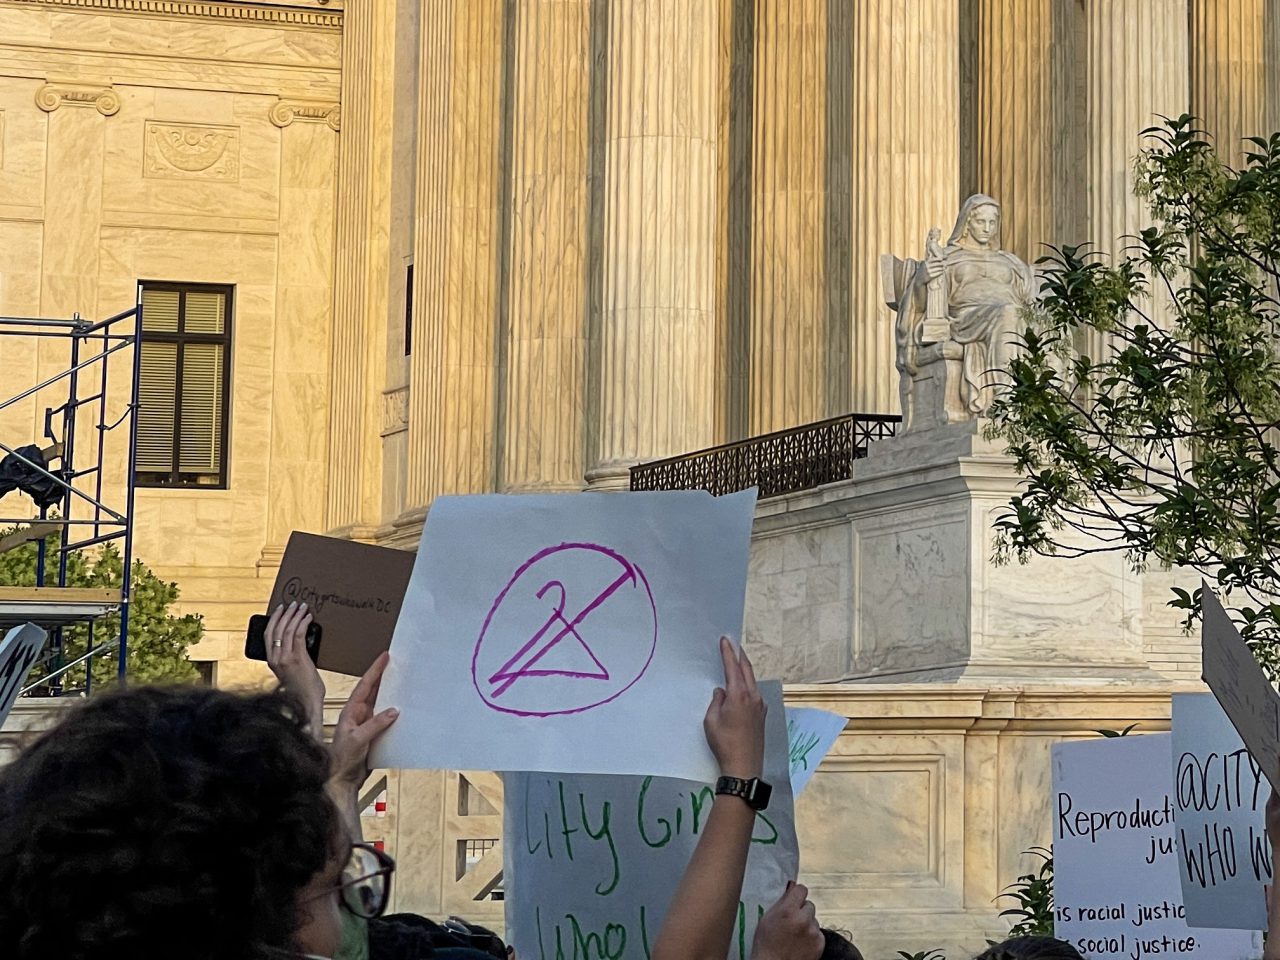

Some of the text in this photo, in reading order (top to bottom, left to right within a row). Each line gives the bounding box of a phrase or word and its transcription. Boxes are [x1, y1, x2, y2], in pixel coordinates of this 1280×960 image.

[637, 775, 778, 848] Girs
[1058, 792, 1176, 843] Reproducti
[1181, 823, 1238, 888] WHO
[1056, 899, 1186, 927] is racial justic
[1077, 934, 1126, 955] social
